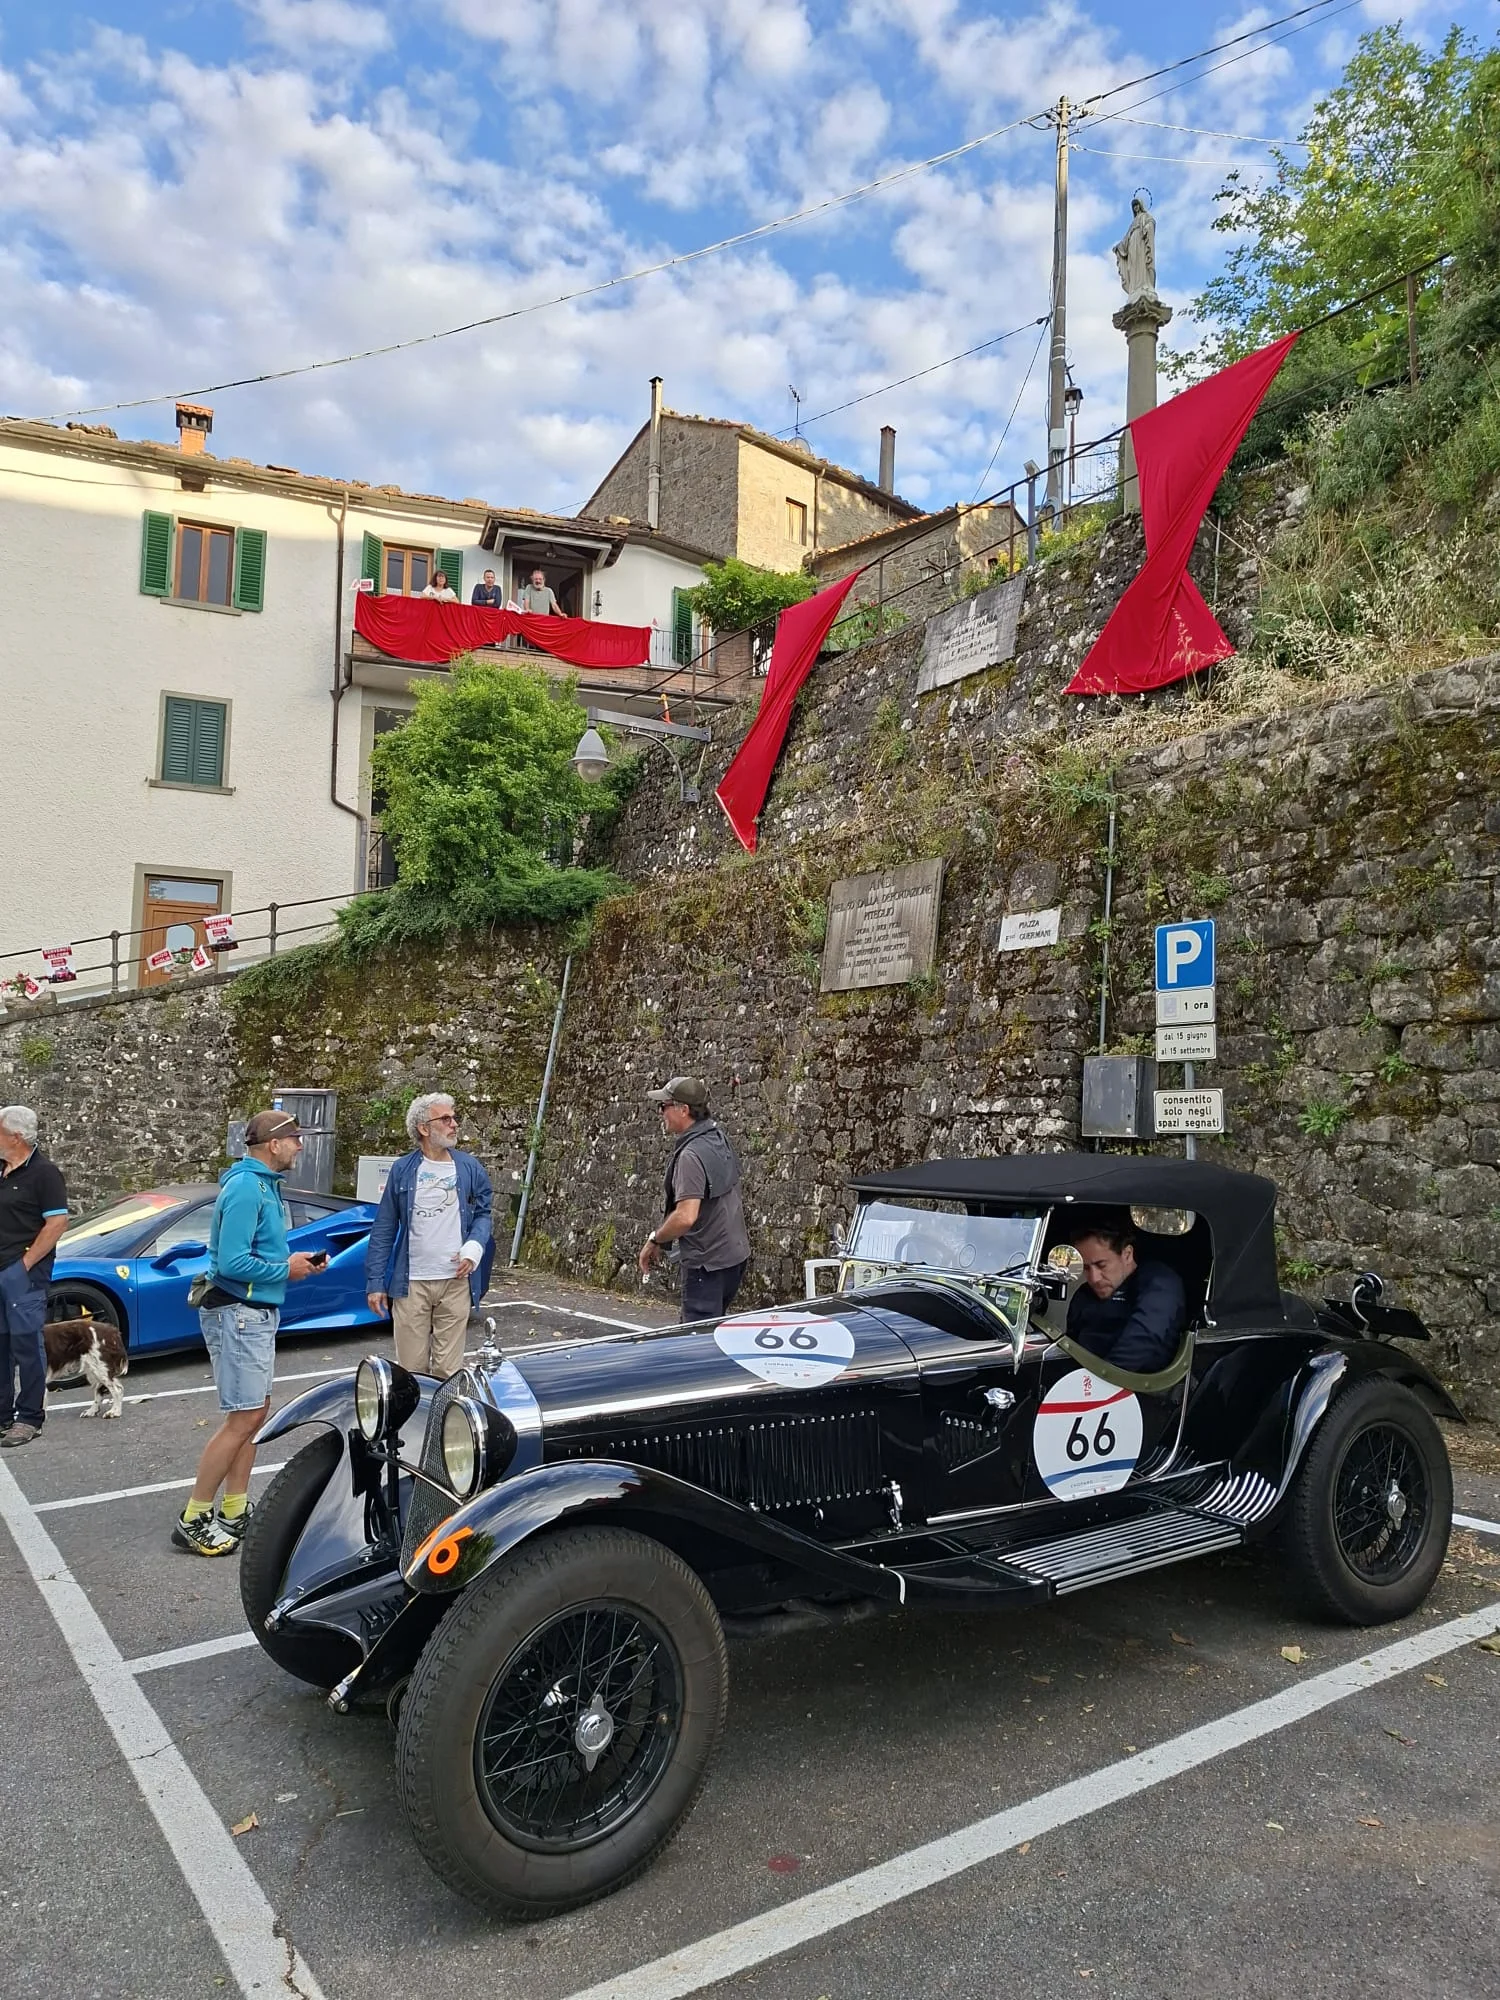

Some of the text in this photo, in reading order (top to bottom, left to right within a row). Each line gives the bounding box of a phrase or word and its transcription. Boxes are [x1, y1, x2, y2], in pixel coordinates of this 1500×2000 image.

[1018, 919, 1040, 929] PIAZZA
[1167, 929, 1202, 984] P
[1184, 1001, 1188, 1011] 1
[1164, 1032, 1174, 1040] dal
[1186, 1032, 1207, 1041] giugno
[1161, 1045, 1211, 1055] al 15 settembre
[1163, 1095, 1212, 1104] consentito
[1164, 1106, 1212, 1117] solo negli
[1158, 1118, 1219, 1128] spazi segnati
[754, 1326, 818, 1350] 66
[1066, 1411, 1116, 1462] 66
